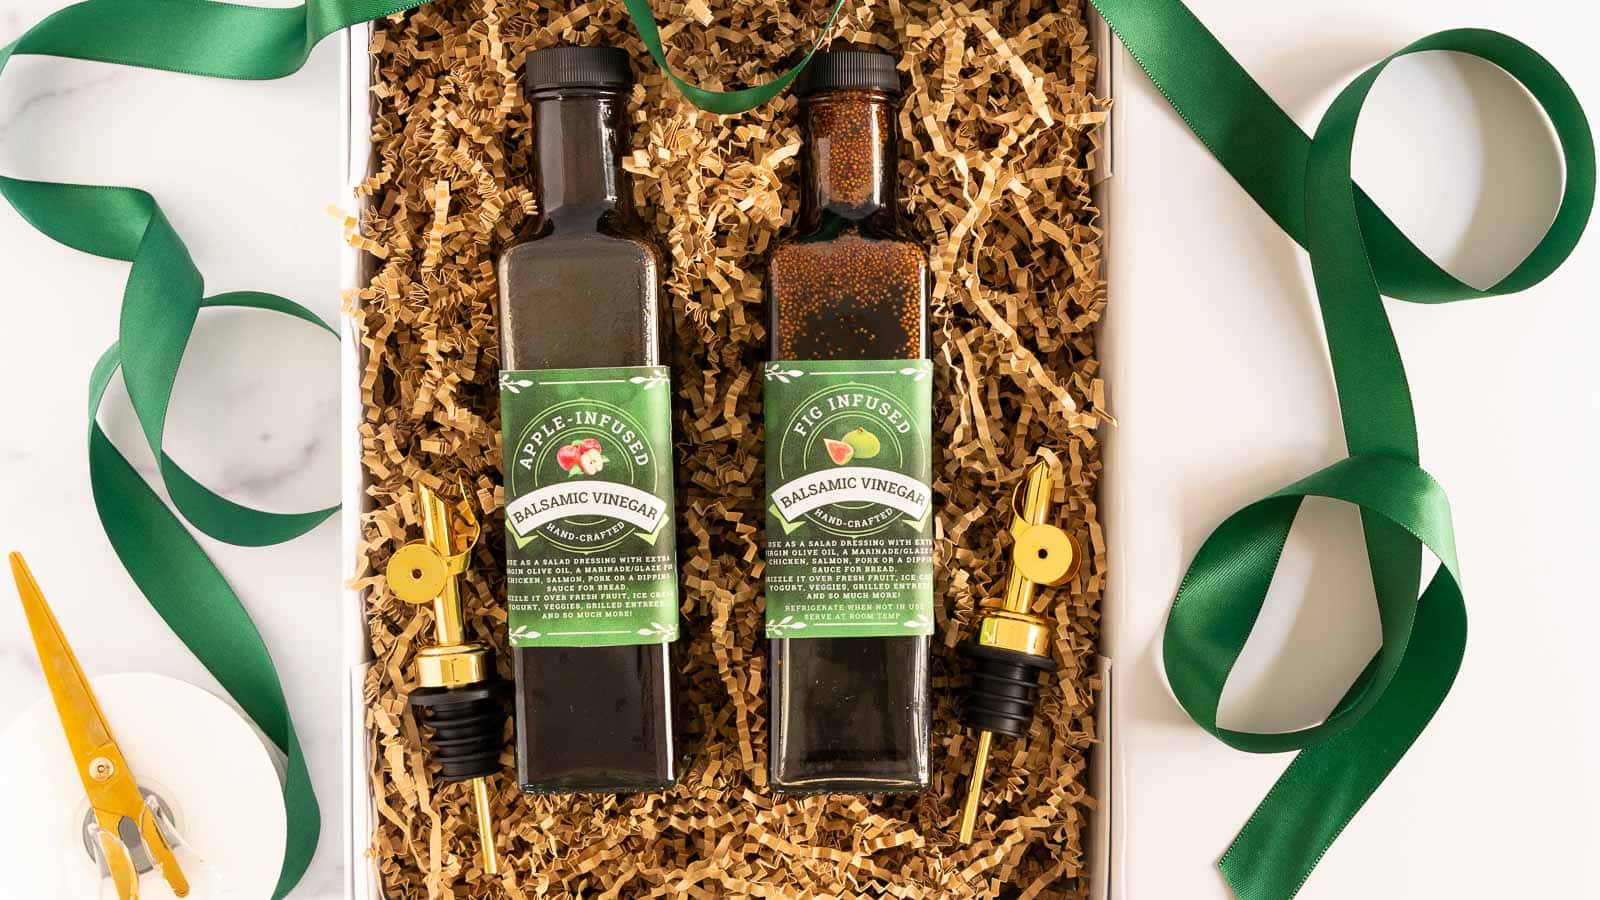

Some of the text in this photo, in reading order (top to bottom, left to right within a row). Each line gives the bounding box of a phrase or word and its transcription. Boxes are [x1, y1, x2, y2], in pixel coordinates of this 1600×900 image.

[793, 393, 911, 437] FIG INFUSED
[519, 411, 649, 470] APPLE-INFUSED
[779, 477, 925, 509] BALSAMIC VINEGAR
[513, 491, 658, 523] BALSAMIC VINEGAR
[814, 507, 894, 528] HAND-CRAFTED
[546, 521, 625, 542] HAND-CRAFTED
[574, 557, 616, 565] DRESSING
[584, 564, 662, 574] MARINADE/GLAZE
